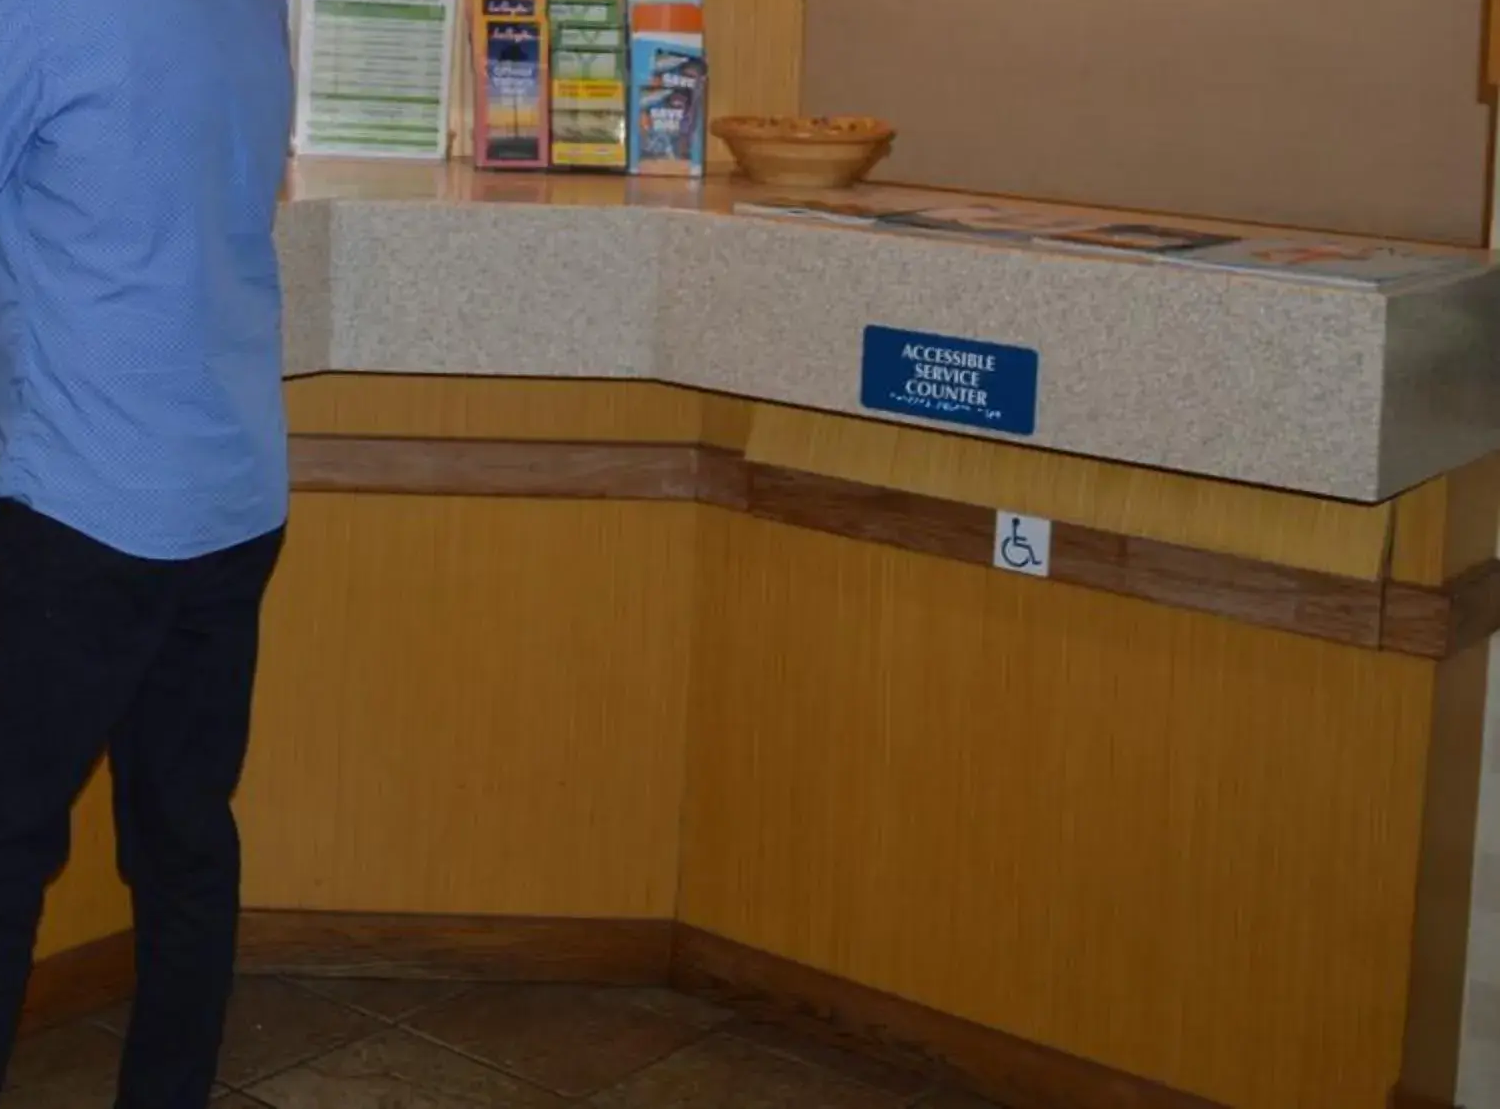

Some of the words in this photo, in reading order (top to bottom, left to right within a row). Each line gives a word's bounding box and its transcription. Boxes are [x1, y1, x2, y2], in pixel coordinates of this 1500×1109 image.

[902, 343, 997, 371] ACCESSIBLE
[915, 363, 980, 387] SERVICE
[905, 379, 988, 406] COUNTER
